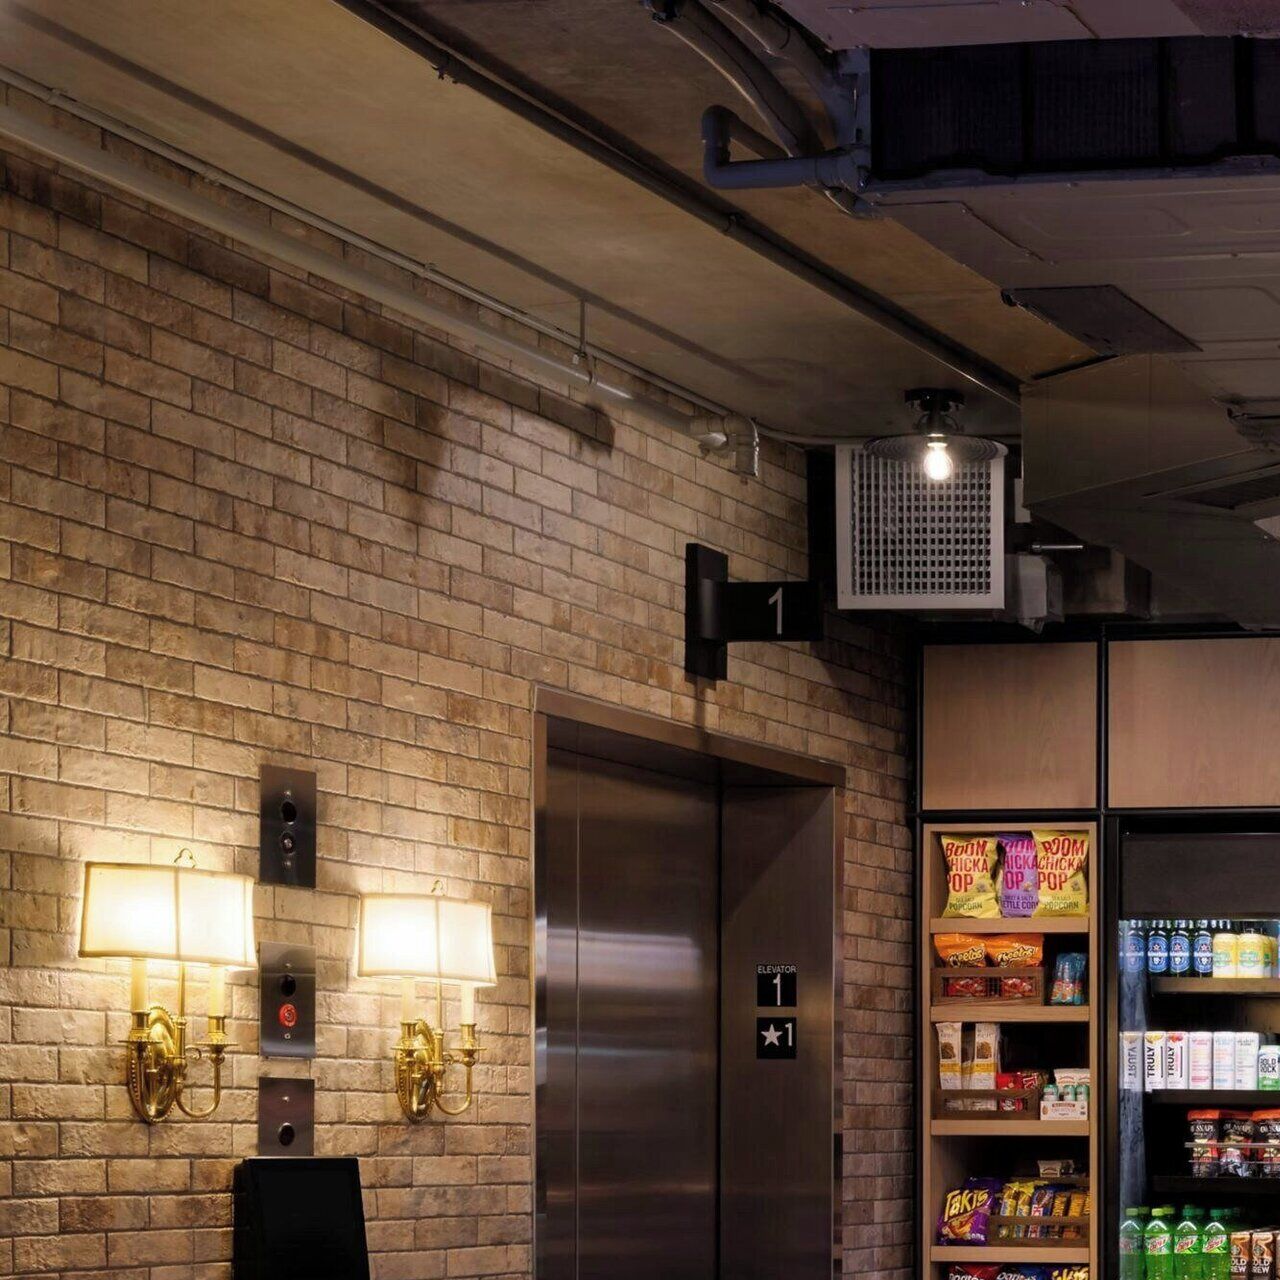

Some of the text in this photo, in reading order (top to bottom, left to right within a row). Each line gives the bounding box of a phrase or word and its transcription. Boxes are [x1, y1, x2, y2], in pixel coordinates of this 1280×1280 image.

[768, 586, 783, 635] 1
[1042, 837, 1085, 857] BOOM
[1004, 855, 1037, 870] HICKA
[1037, 854, 1083, 872] CHICKA
[1004, 871, 1025, 890] OP
[1037, 872, 1068, 891] POP
[948, 901, 983, 912] POPCORN
[1043, 900, 1079, 911] POPCORN
[758, 965, 797, 974] ELEVATOR
[773, 973, 781, 1006] 1
[785, 1022, 793, 1047] 1
[1147, 1046, 1155, 1079] TRULY
[1167, 1046, 1175, 1077] TRULY
[943, 1188, 990, 1222] Takis
